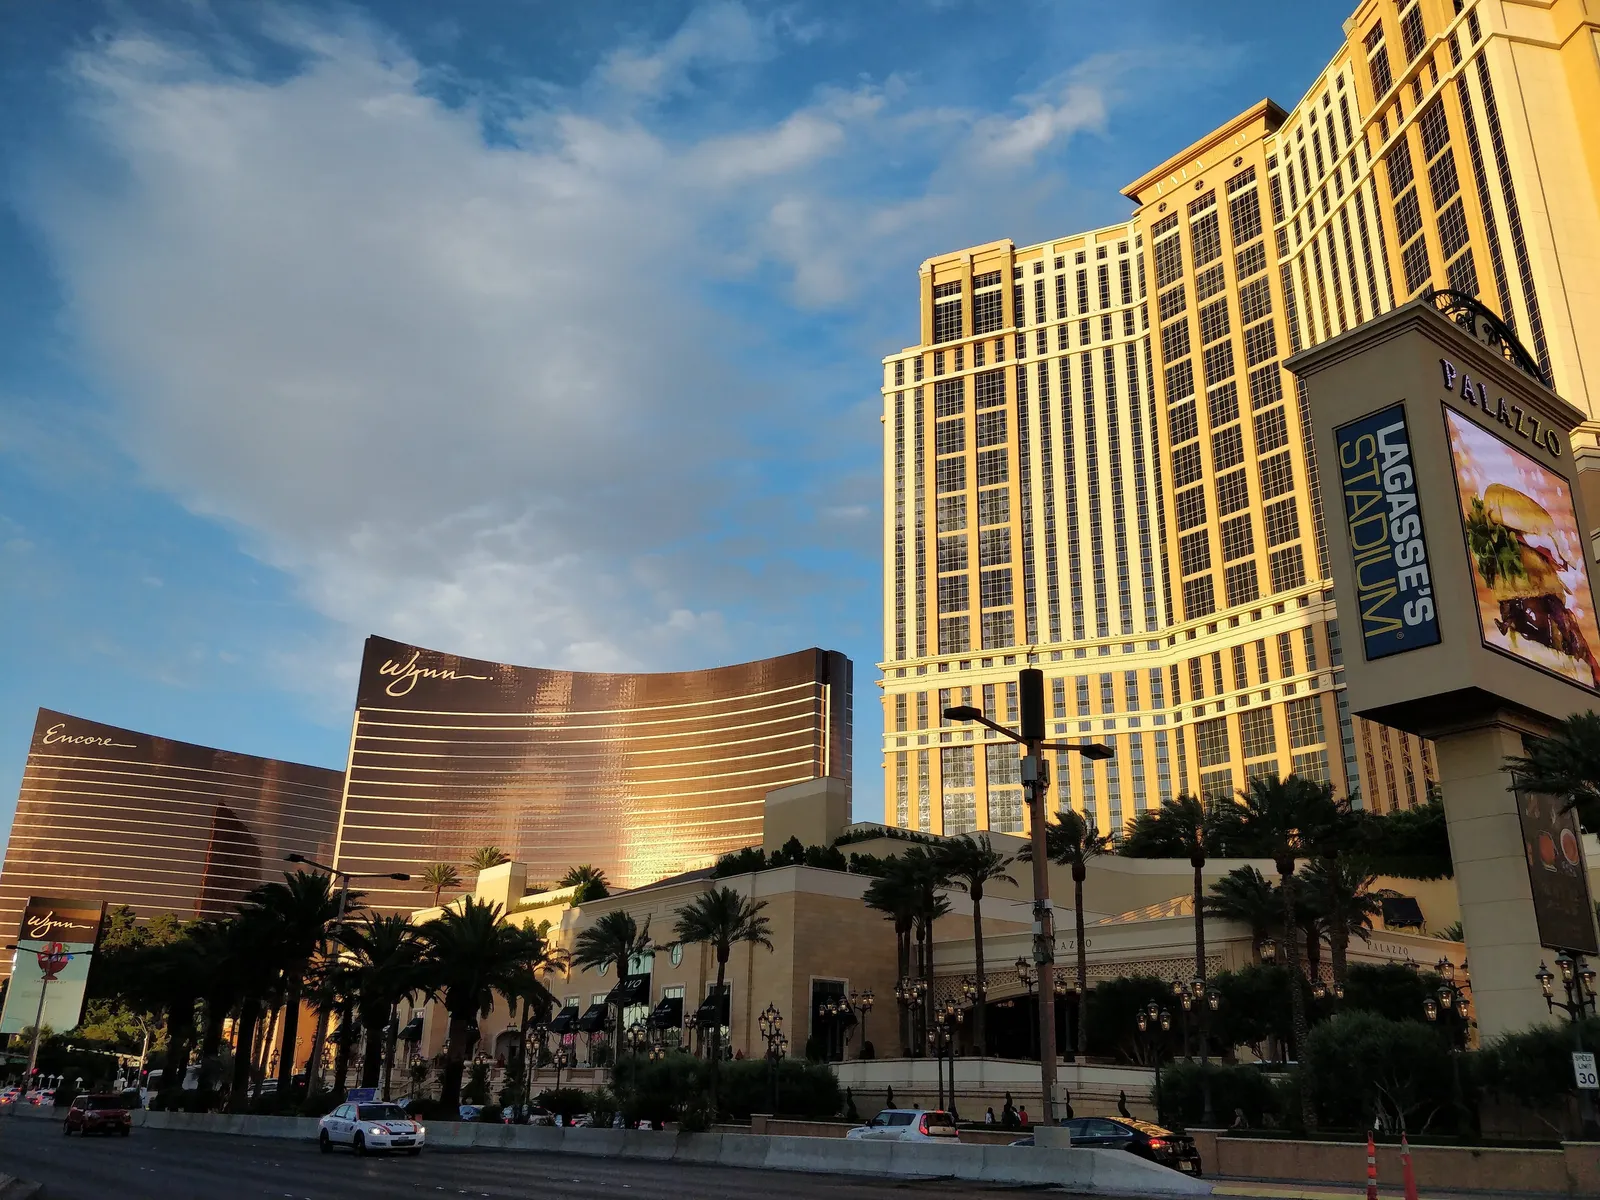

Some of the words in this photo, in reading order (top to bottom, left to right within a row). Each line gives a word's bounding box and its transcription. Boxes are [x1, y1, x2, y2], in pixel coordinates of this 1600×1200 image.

[1440, 358, 1562, 457] PALAZZO
[1376, 421, 1434, 626] LAGASSE'S
[42, 723, 137, 747] Encore
[1367, 940, 1409, 955] PALAZZO
[1579, 1072, 1596, 1085] 30
